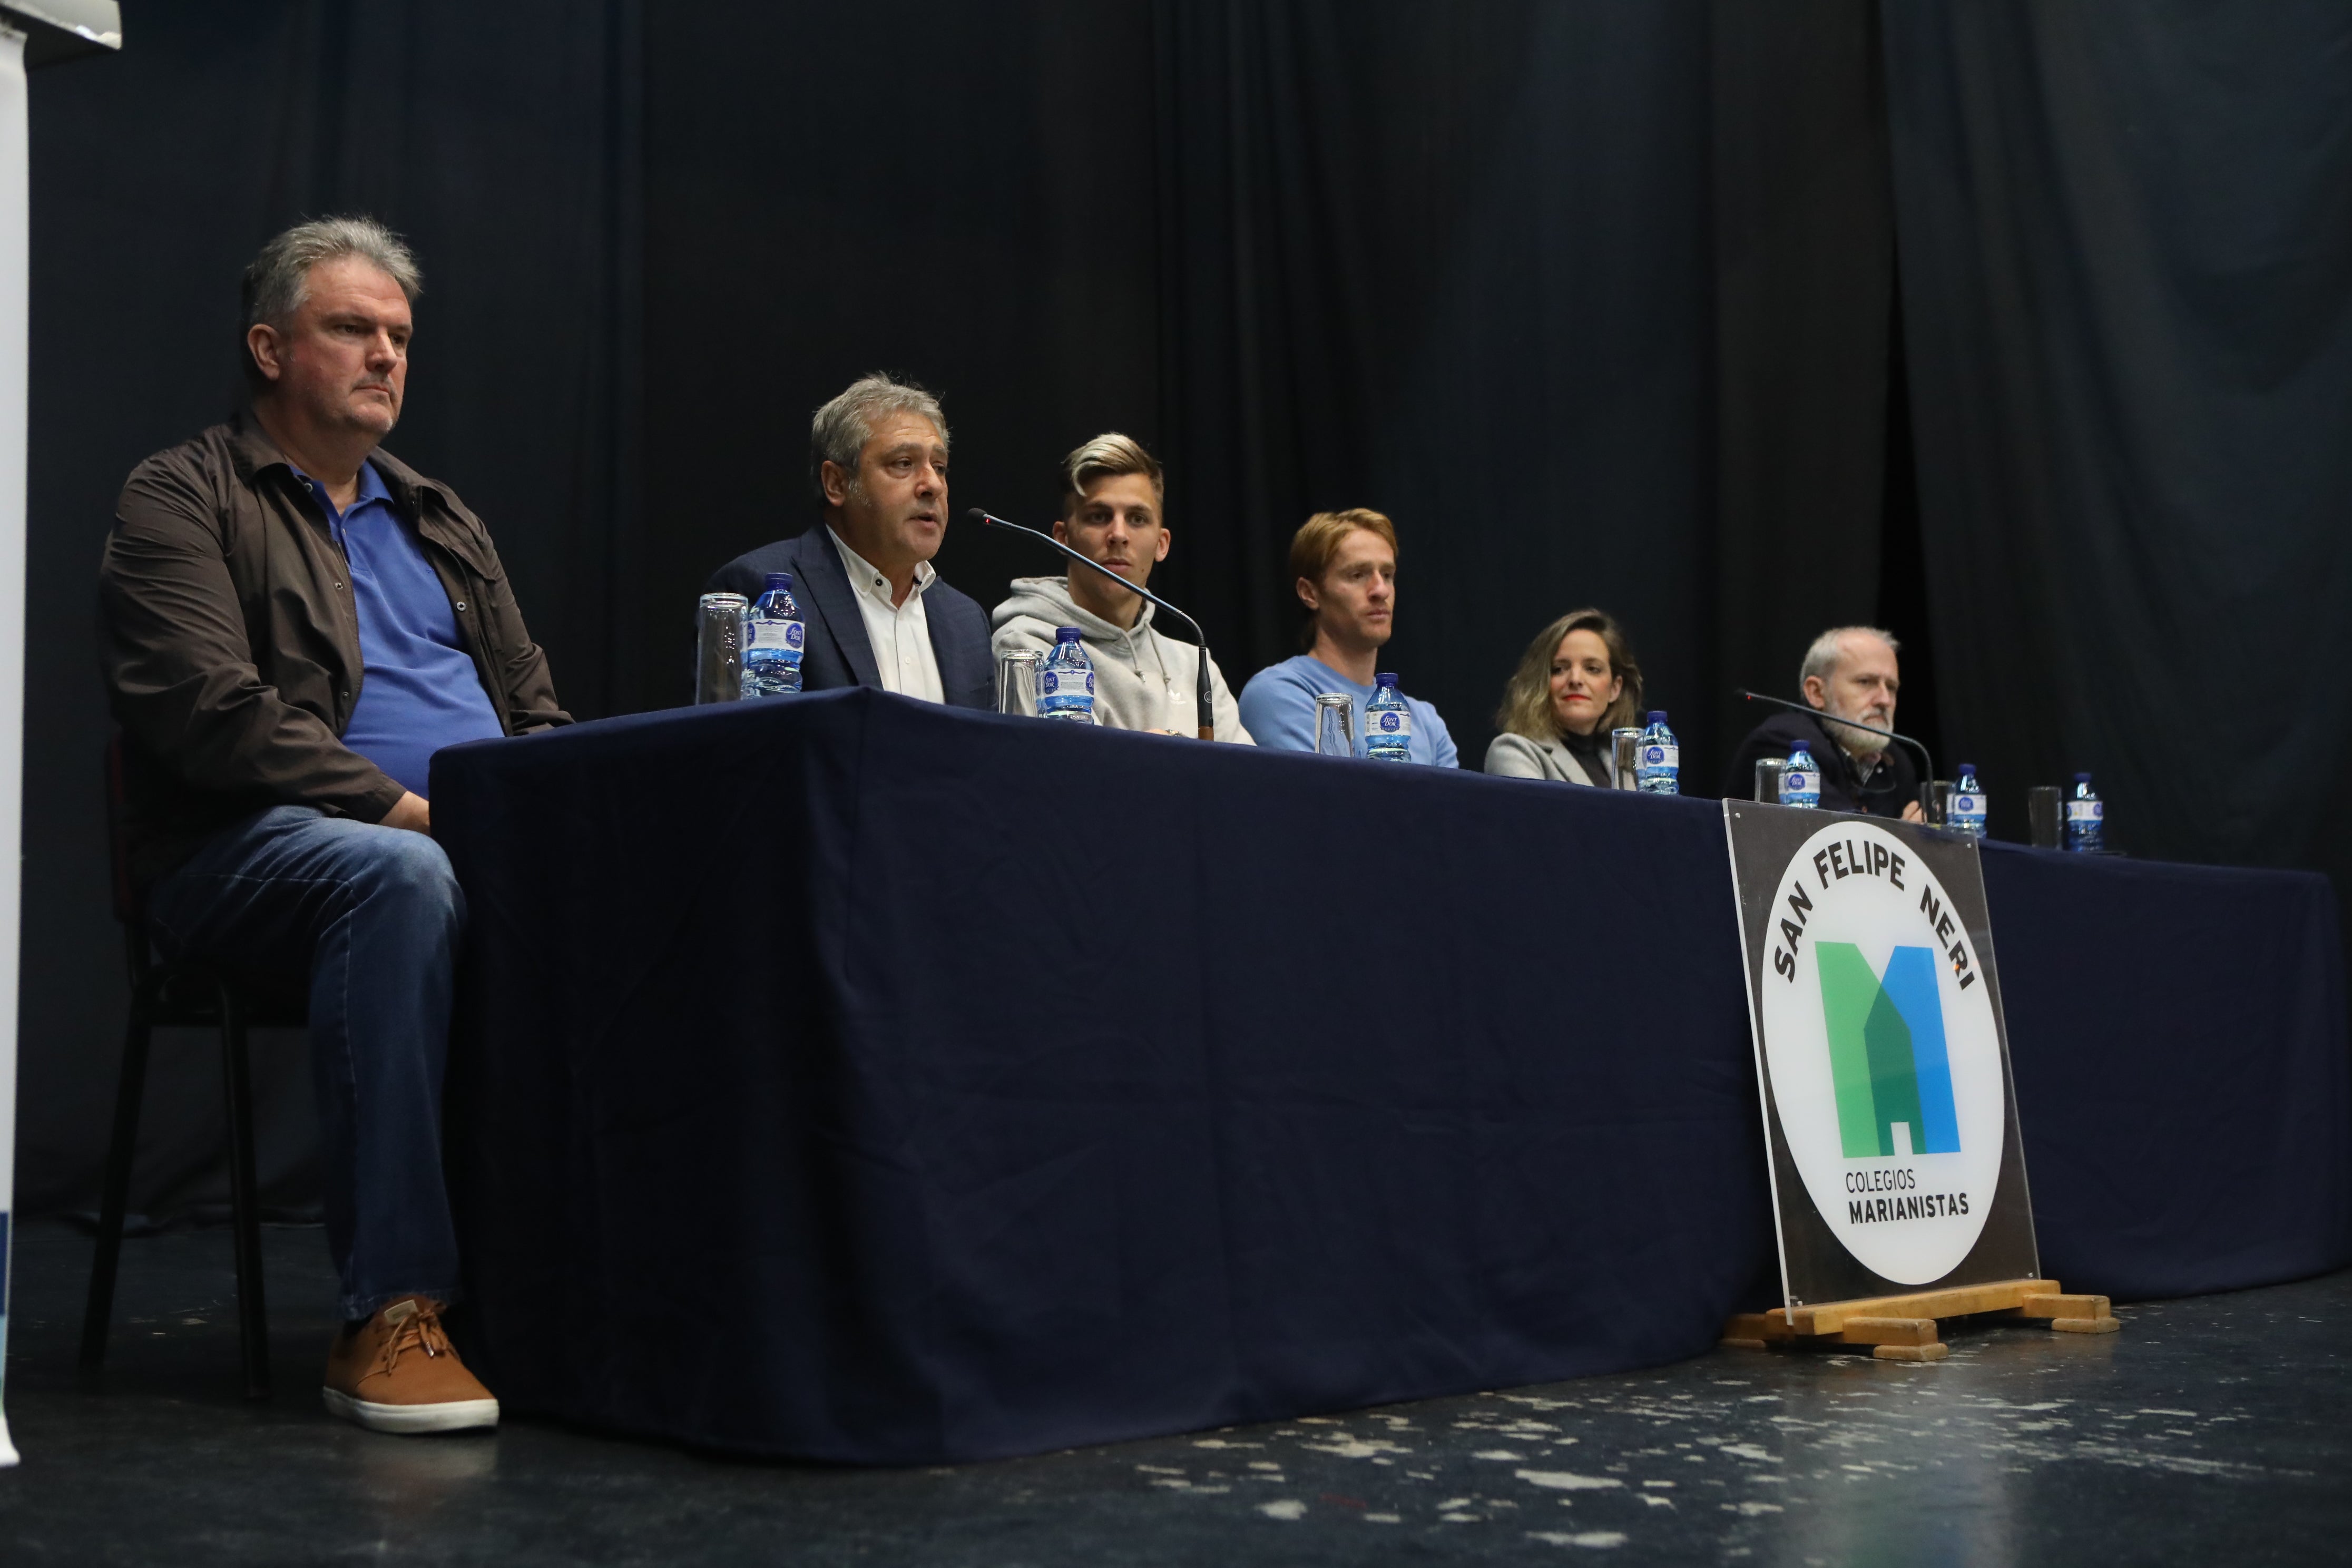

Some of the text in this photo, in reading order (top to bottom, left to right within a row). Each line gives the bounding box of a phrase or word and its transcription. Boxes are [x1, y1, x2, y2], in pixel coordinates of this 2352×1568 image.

[1774, 839, 1975, 991] SAN FELIPE NERI
[1846, 1169, 1916, 1193] COLEGIOS
[1848, 1192, 1969, 1224] MARIANISTAS
